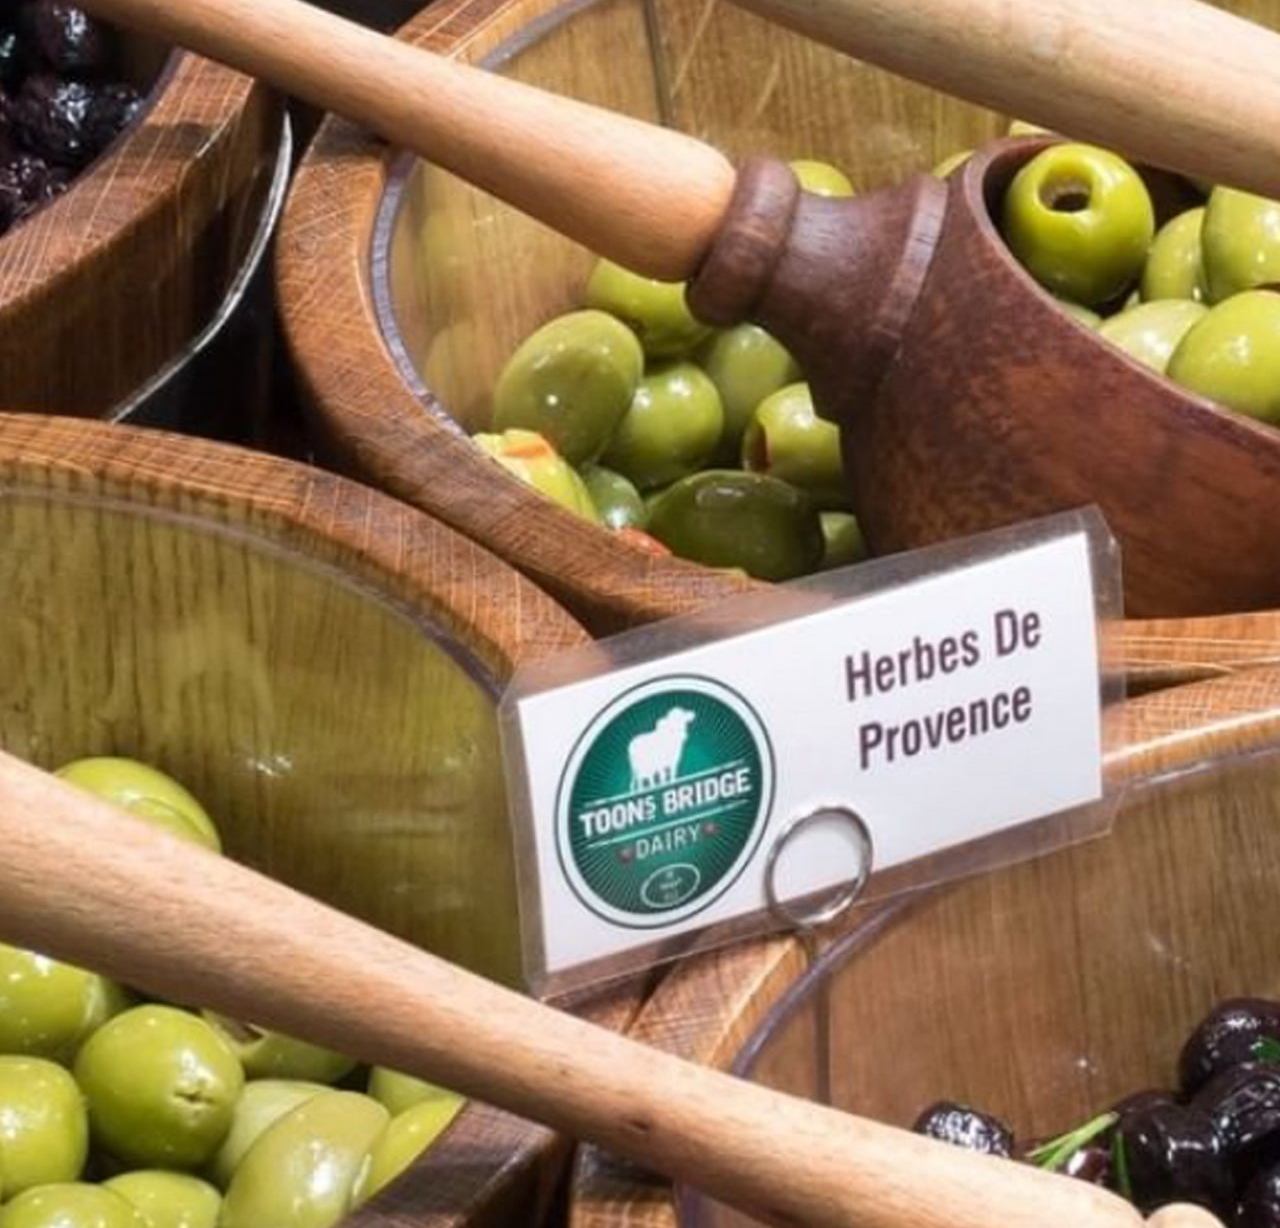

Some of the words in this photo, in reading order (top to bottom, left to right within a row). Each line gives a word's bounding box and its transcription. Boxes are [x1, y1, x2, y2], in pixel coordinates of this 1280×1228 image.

[845, 636, 981, 703] Herbes
[994, 609, 1041, 658] De
[859, 685, 1033, 771] Provence
[662, 767, 753, 815] BRIDGE
[635, 824, 701, 860] DAIRY
